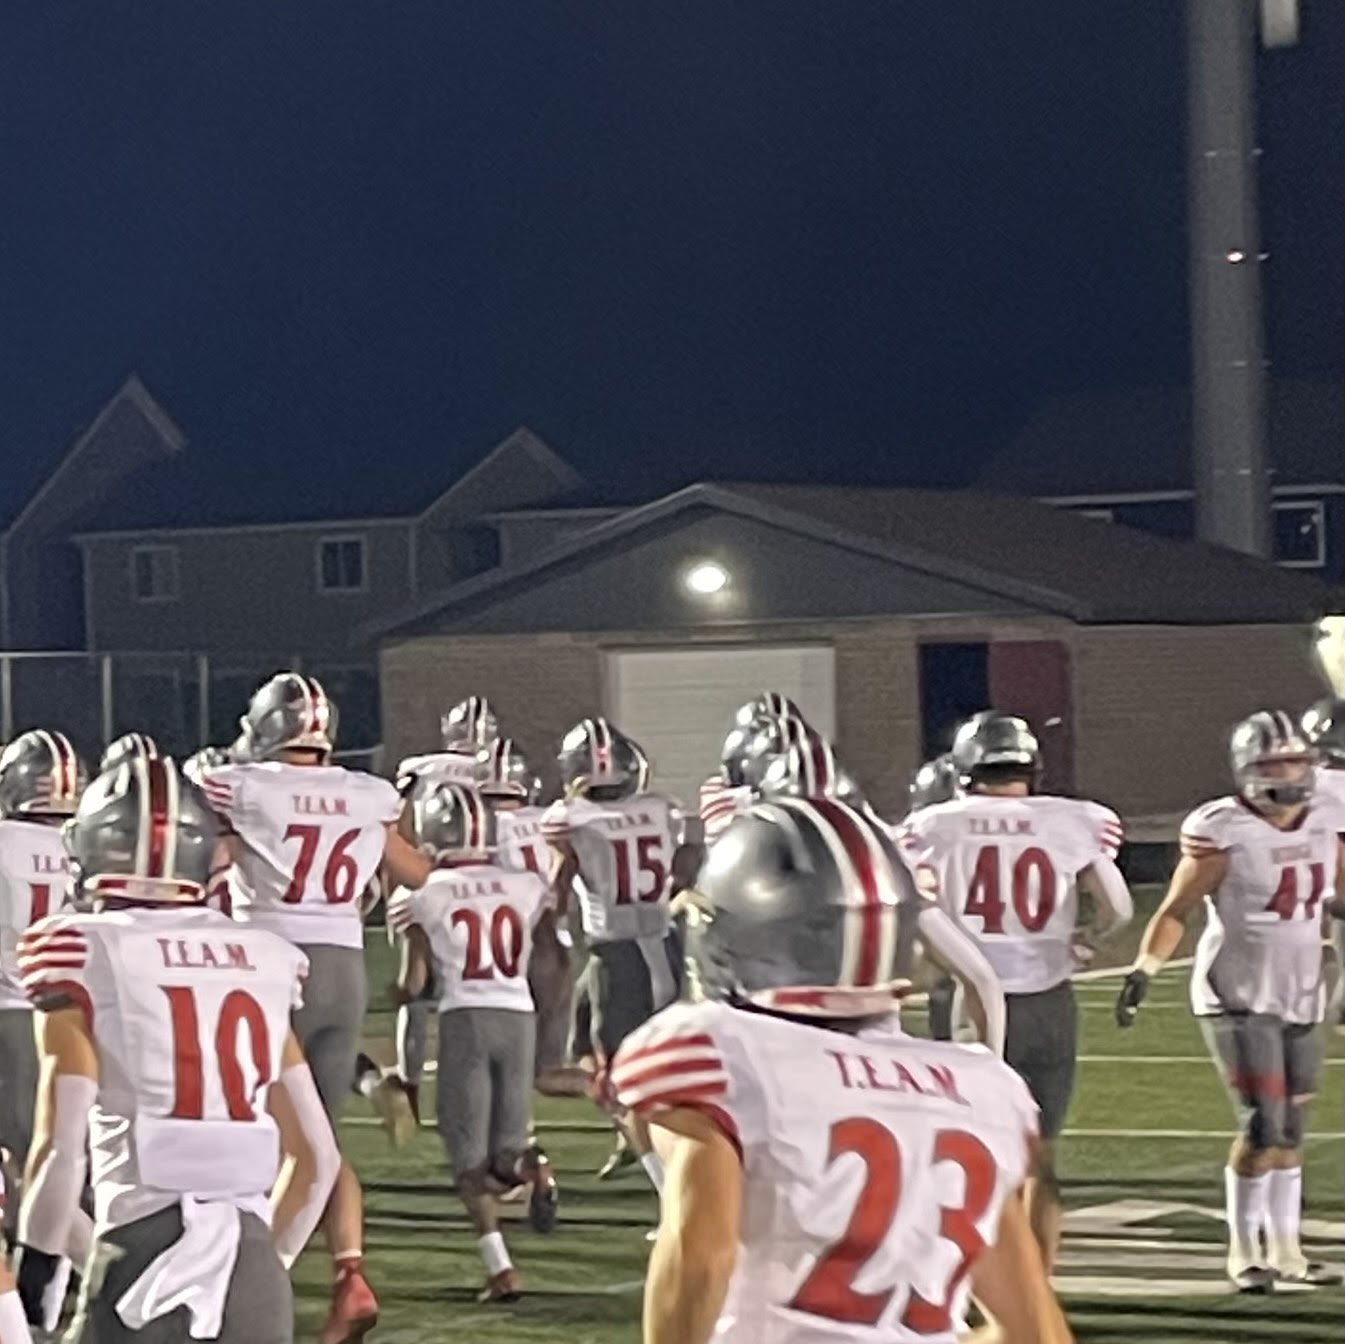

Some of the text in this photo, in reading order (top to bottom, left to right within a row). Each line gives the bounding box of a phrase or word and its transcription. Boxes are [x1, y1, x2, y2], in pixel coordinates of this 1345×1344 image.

[280, 823, 362, 904] 76
[611, 834, 665, 906] 15
[963, 844, 1057, 935] 40
[1264, 861, 1325, 922] 41
[451, 904, 523, 981] 20
[156, 985, 272, 1122] 10
[786, 1115, 998, 1336] 23
